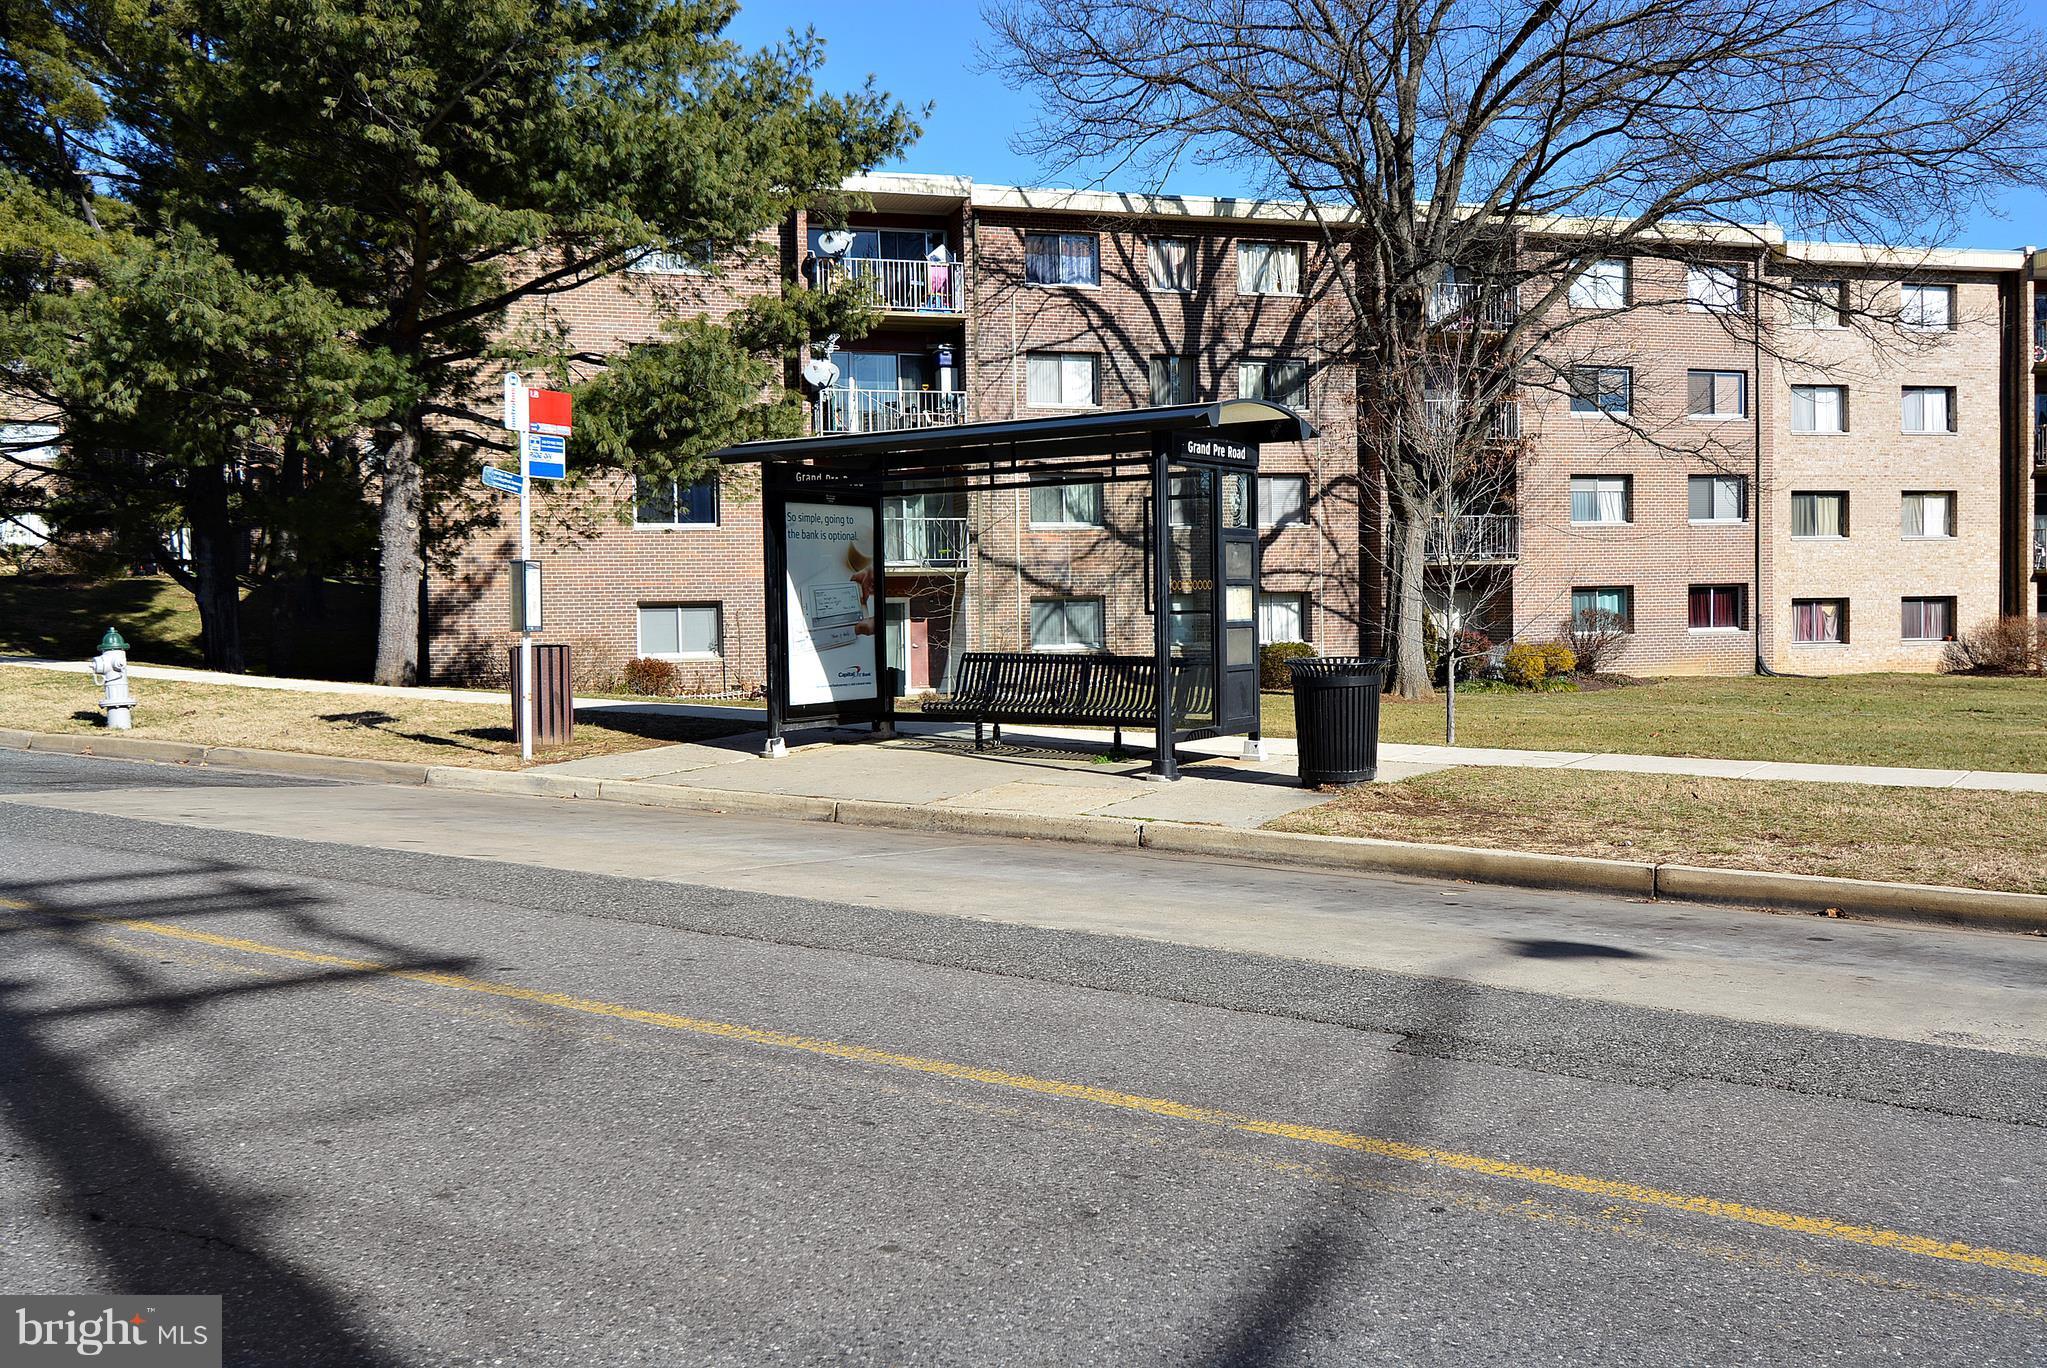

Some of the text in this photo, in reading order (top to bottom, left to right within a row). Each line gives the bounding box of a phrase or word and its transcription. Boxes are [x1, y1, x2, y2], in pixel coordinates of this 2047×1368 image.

[1187, 441, 1246, 460] Grand Pre Road
[795, 472, 822, 482] Grand
[787, 512, 854, 526] So simple, going to
[787, 529, 800, 539] the
[801, 529, 819, 540] bank
[820, 531, 827, 540] is
